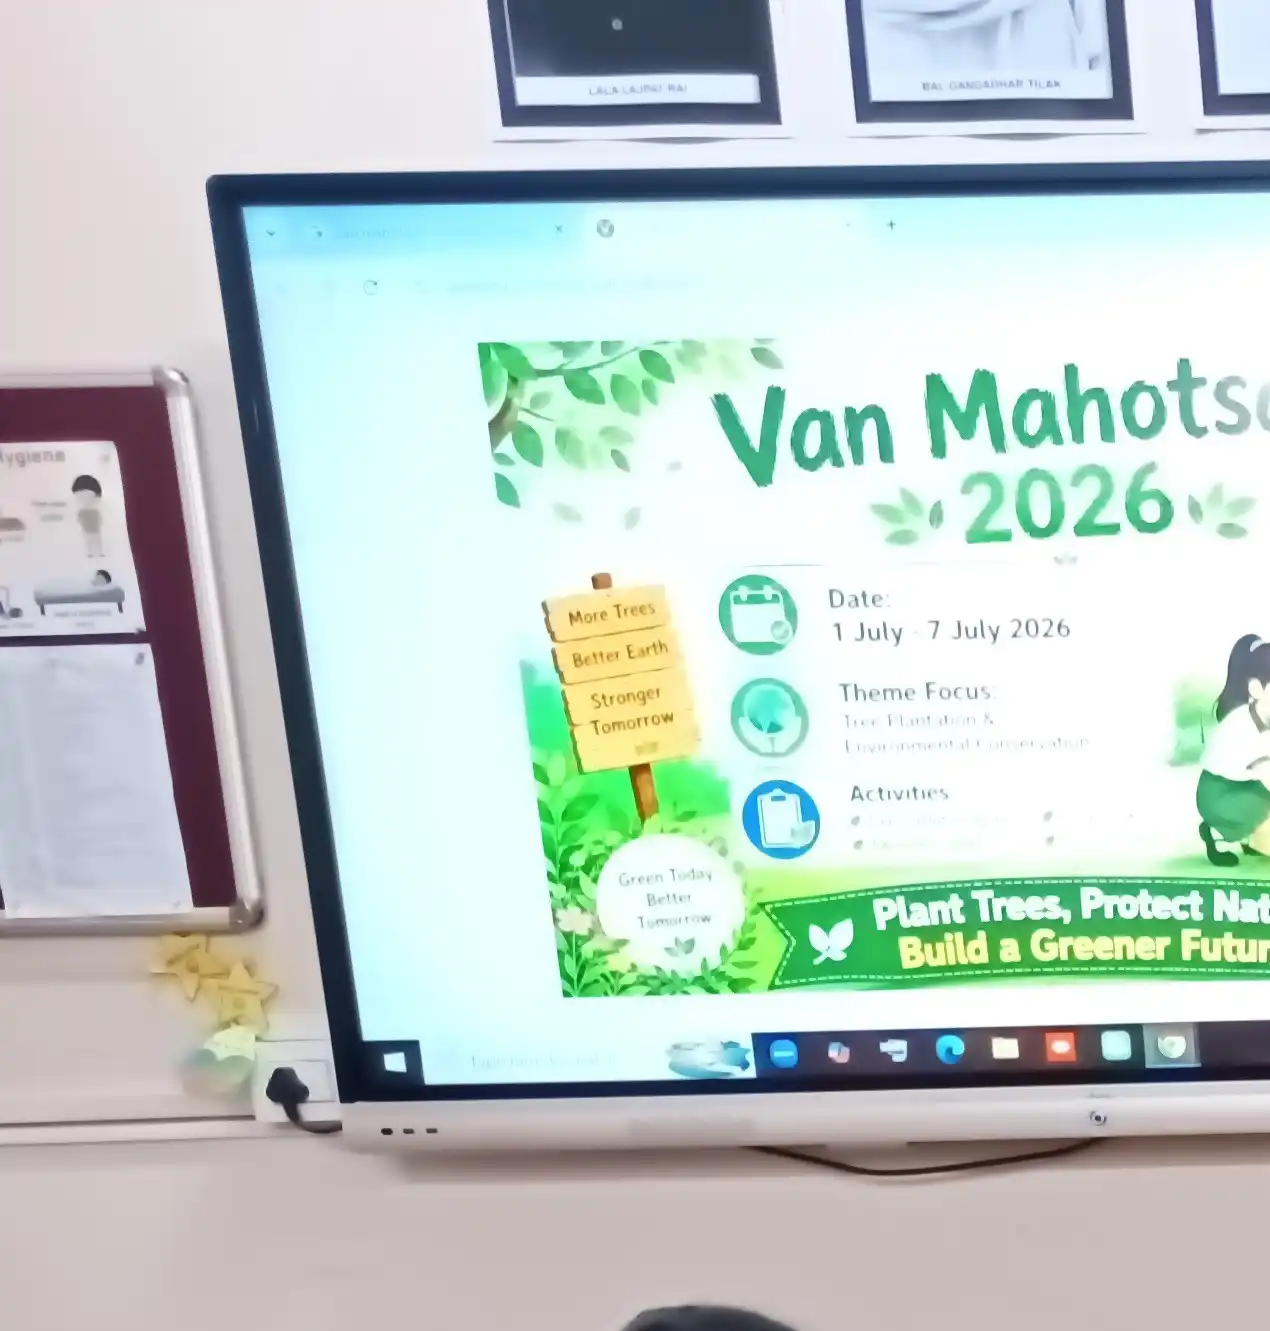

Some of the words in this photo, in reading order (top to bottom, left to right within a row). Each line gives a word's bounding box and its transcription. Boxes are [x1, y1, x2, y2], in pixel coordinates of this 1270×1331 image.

[711, 385, 895, 488] Van
[0, 449, 66, 470] ygiene
[960, 462, 1175, 544] 2026
[567, 609, 608, 628] More
[612, 602, 656, 620] Trees
[833, 622, 843, 642] 1
[854, 621, 903, 647] July
[927, 619, 940, 640] 7
[951, 618, 1001, 645] July
[1009, 617, 1071, 639] 2026
[572, 650, 620, 669] Better
[625, 639, 669, 661] Earth
[590, 687, 661, 710] Stronger
[838, 683, 917, 702] Theme
[590, 711, 674, 736] Tomorrow
[619, 872, 664, 887] Green
[667, 867, 712, 883] Today
[646, 891, 691, 907] Better
[872, 896, 966, 931] Plant
[970, 888, 1072, 926] Trees,
[1079, 886, 1205, 923] Protect
[636, 914, 713, 930] Tomorrow
[898, 929, 989, 970] Build
[999, 936, 1022, 964] a
[1030, 928, 1172, 963] Greener
